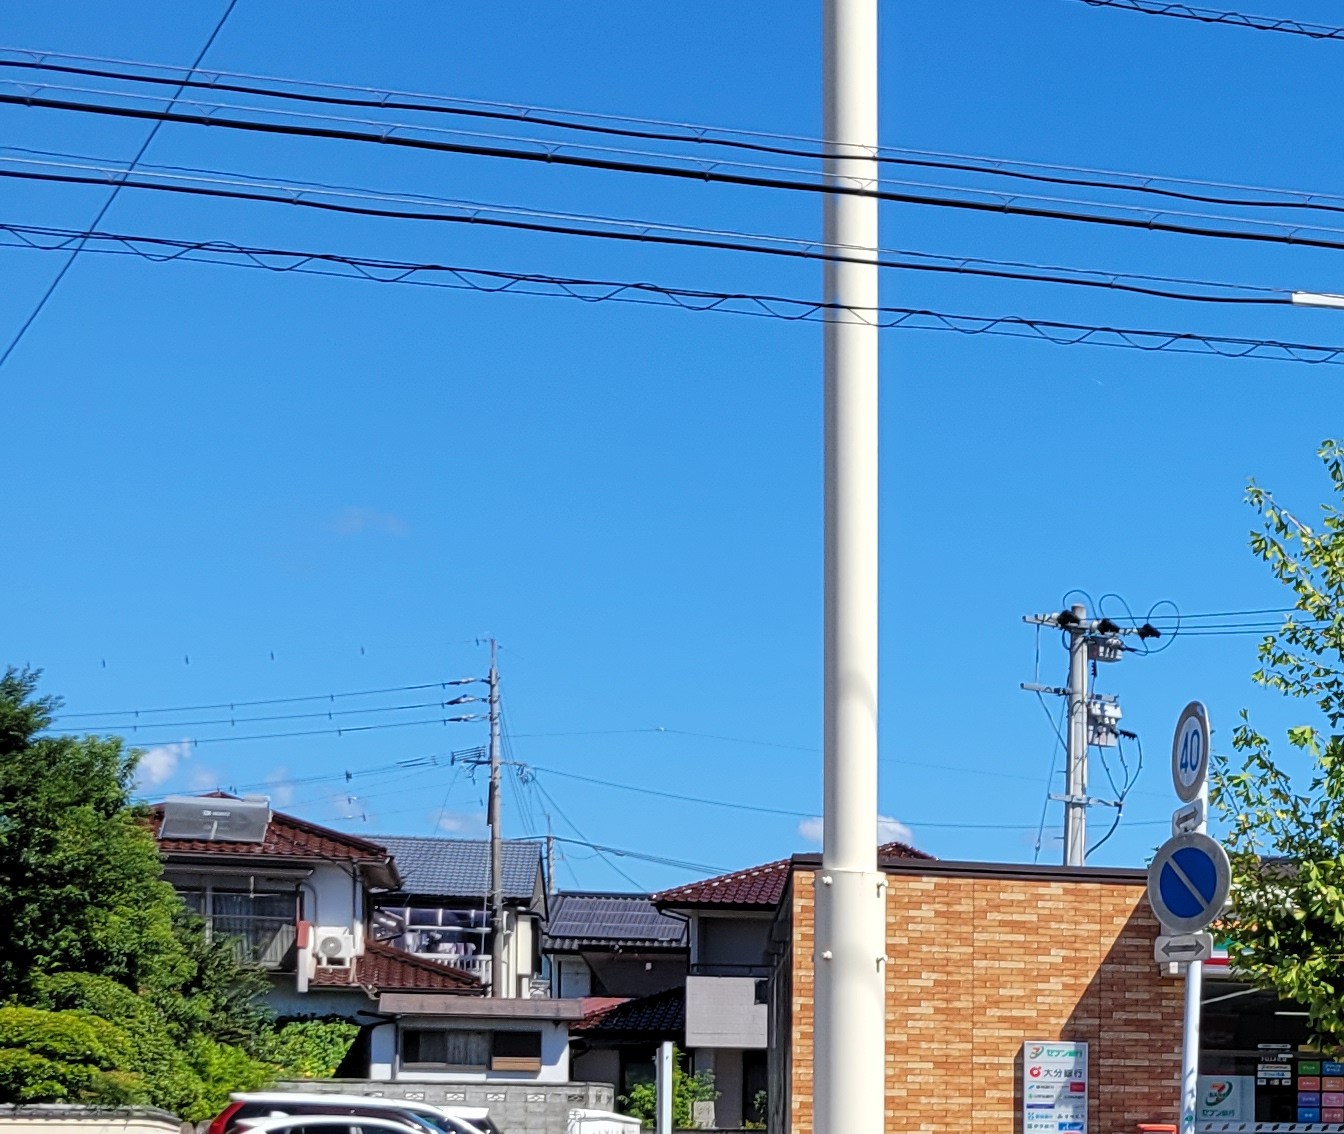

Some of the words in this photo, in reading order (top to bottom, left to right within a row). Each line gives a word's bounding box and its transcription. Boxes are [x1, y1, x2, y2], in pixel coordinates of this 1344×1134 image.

[1180, 729, 1200, 774] 40
[1043, 1068, 1083, 1079] 大分銀行
